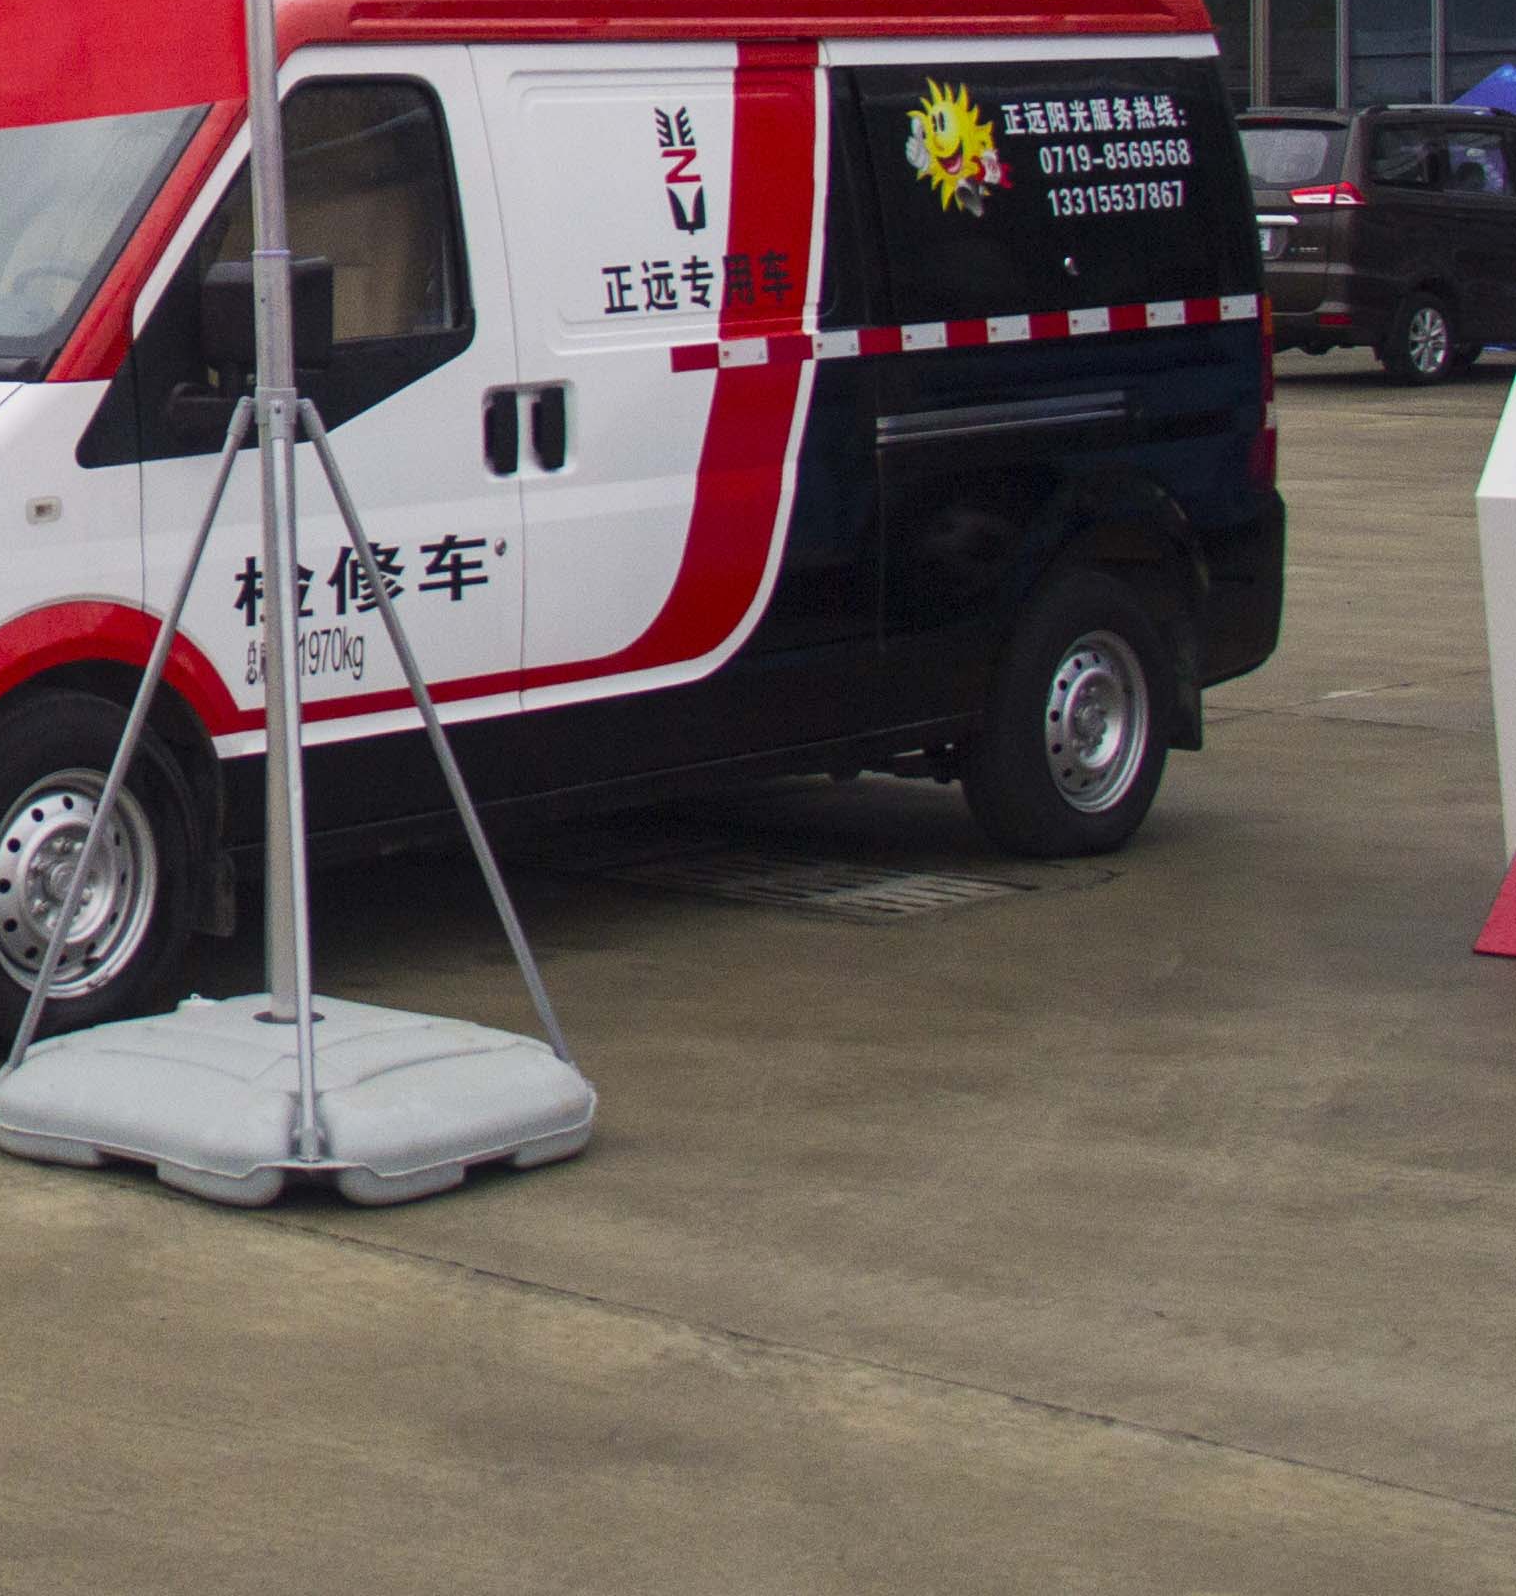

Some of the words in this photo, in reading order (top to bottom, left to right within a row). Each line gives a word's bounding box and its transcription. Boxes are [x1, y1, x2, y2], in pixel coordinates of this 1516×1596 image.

[1000, 95, 1187, 135] 正远阳光服务热线：
[1039, 138, 1192, 174] 0719-8569568
[1047, 180, 1185, 217] 13315537867
[601, 250, 793, 314] 正远专用车
